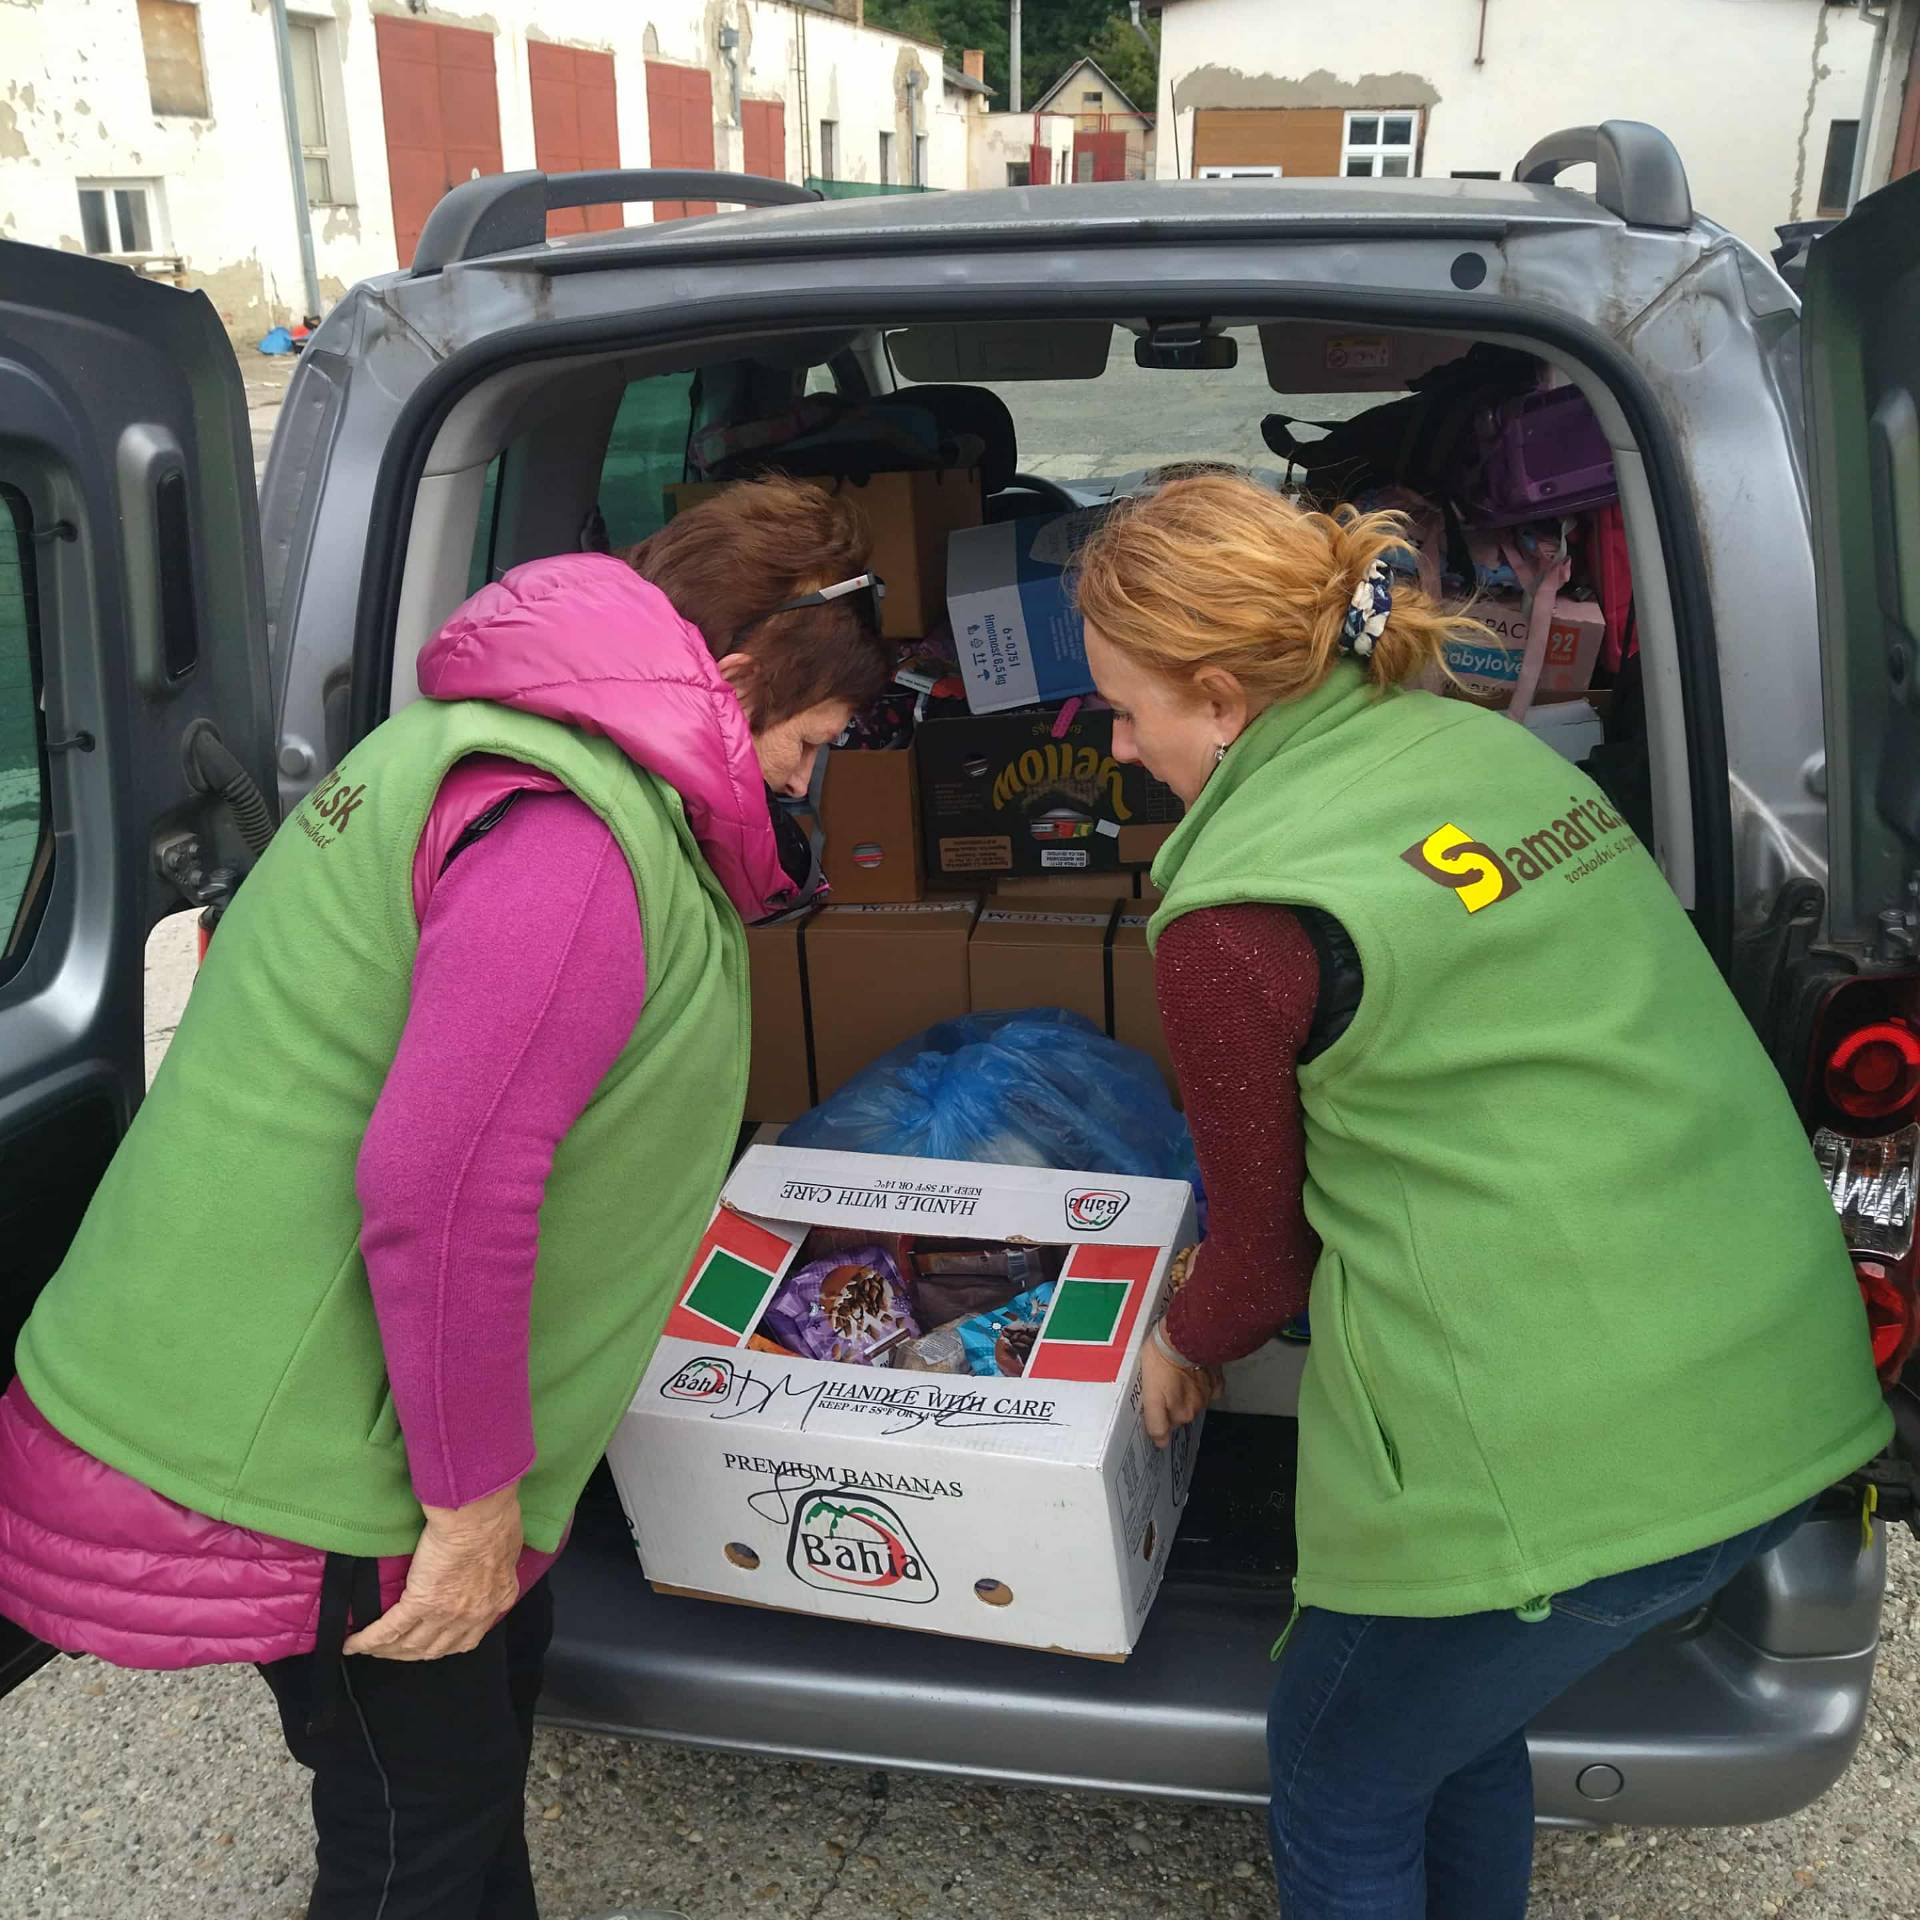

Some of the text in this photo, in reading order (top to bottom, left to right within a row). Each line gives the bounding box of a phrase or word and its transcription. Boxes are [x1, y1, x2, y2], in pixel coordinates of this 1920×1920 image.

[1485, 618, 1529, 640] PAC
[1551, 633, 1575, 652] 92
[1444, 650, 1521, 673] abylove
[995, 673, 1007, 686] kg
[899, 1181, 913, 1190] OR
[939, 1184, 953, 1193] AT
[955, 1186, 982, 1196] KEEP
[780, 1184, 978, 1216] HANDLE WITH CARE
[1068, 1197, 1120, 1214] Bahia
[673, 1373, 728, 1395] Bahia
[817, 1400, 849, 1411] KEEP
[850, 1404, 868, 1413] AT
[896, 1410, 913, 1418] OR
[825, 1381, 1056, 1418] HANDLE WITH CARE
[722, 1452, 963, 1498] PREMIUM BANANAS
[800, 1533, 922, 1581] Bahia
